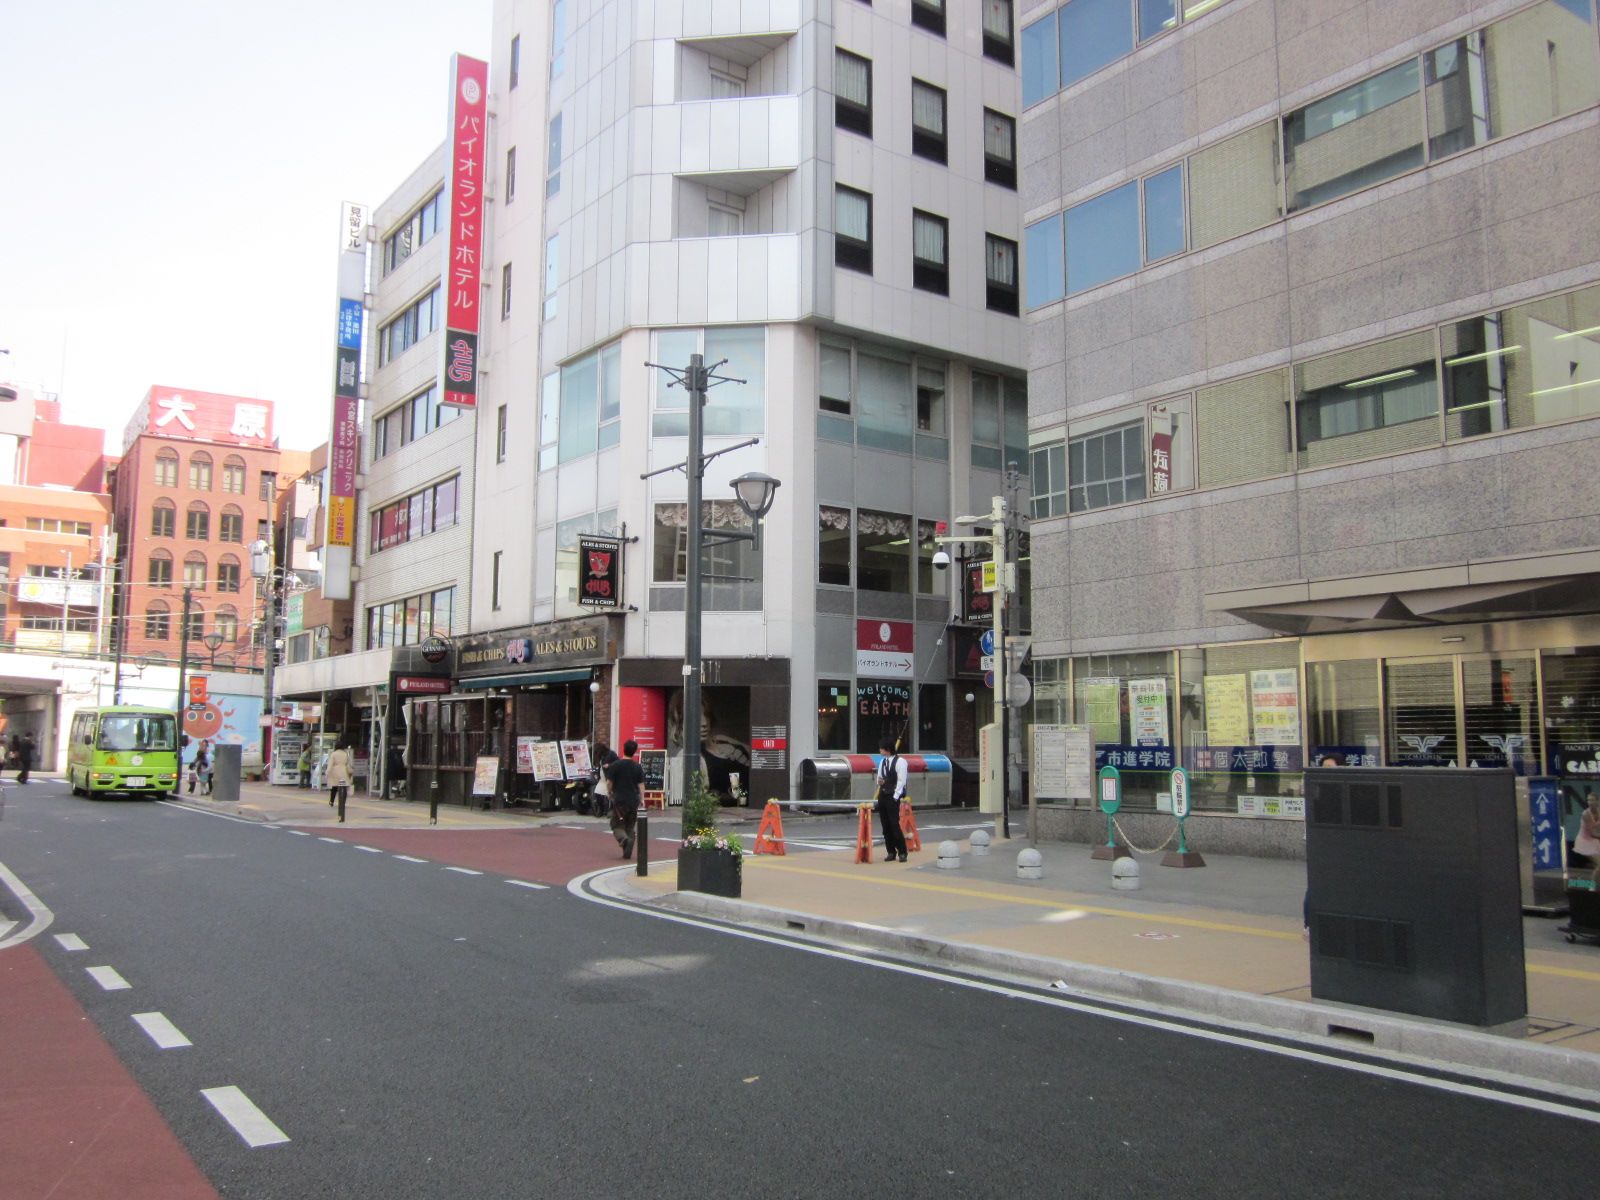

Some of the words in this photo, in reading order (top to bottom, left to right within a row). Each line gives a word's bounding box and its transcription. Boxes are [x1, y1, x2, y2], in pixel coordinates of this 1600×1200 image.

[453, 114, 479, 309] パイオランドホテル
[448, 340, 473, 382] HUB
[156, 396, 268, 440] 大原
[484, 648, 505, 661] CHIPS
[535, 643, 554, 656] ALES
[563, 636, 597, 651] STOUTS
[857, 659, 897, 668] パイオランドホテル
[860, 700, 912, 716] EARTH
[1108, 751, 1171, 768] 市進学院
[1214, 751, 1290, 770] 個太郎塾
